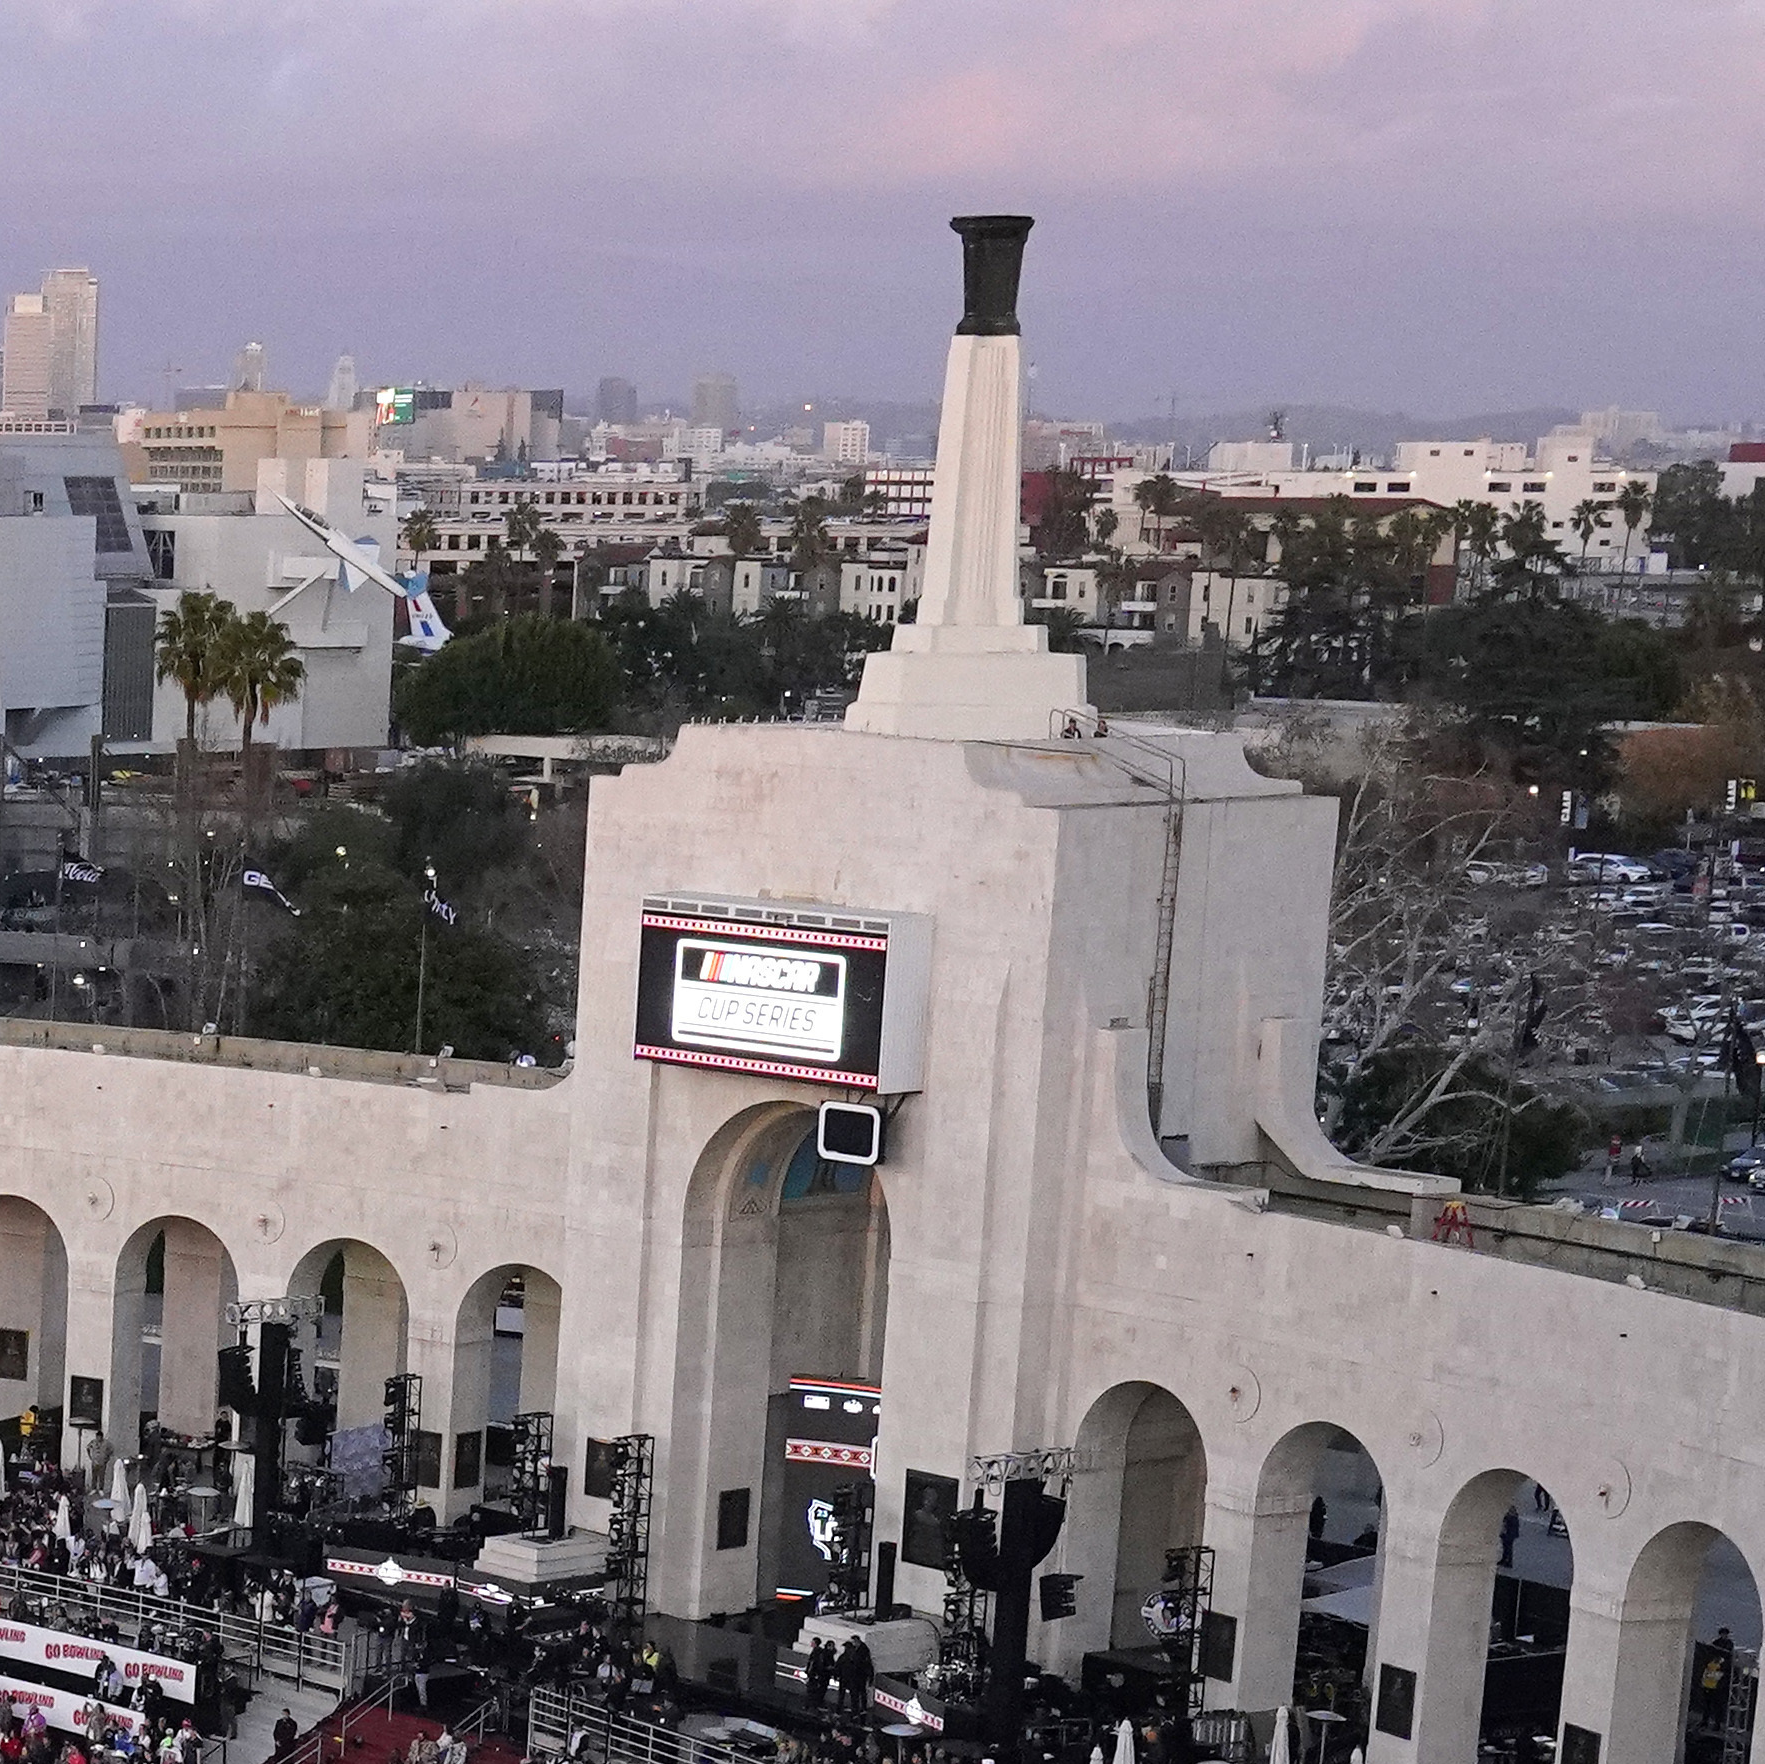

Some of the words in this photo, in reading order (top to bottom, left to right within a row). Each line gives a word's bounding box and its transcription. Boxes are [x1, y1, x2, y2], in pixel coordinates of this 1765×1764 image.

[728, 954, 821, 993] NASCAR
[698, 997, 739, 1022] CUP
[743, 1002, 816, 1032] SERIES
[45, 1644, 60, 1659] GO
[125, 1663, 140, 1677] GO
